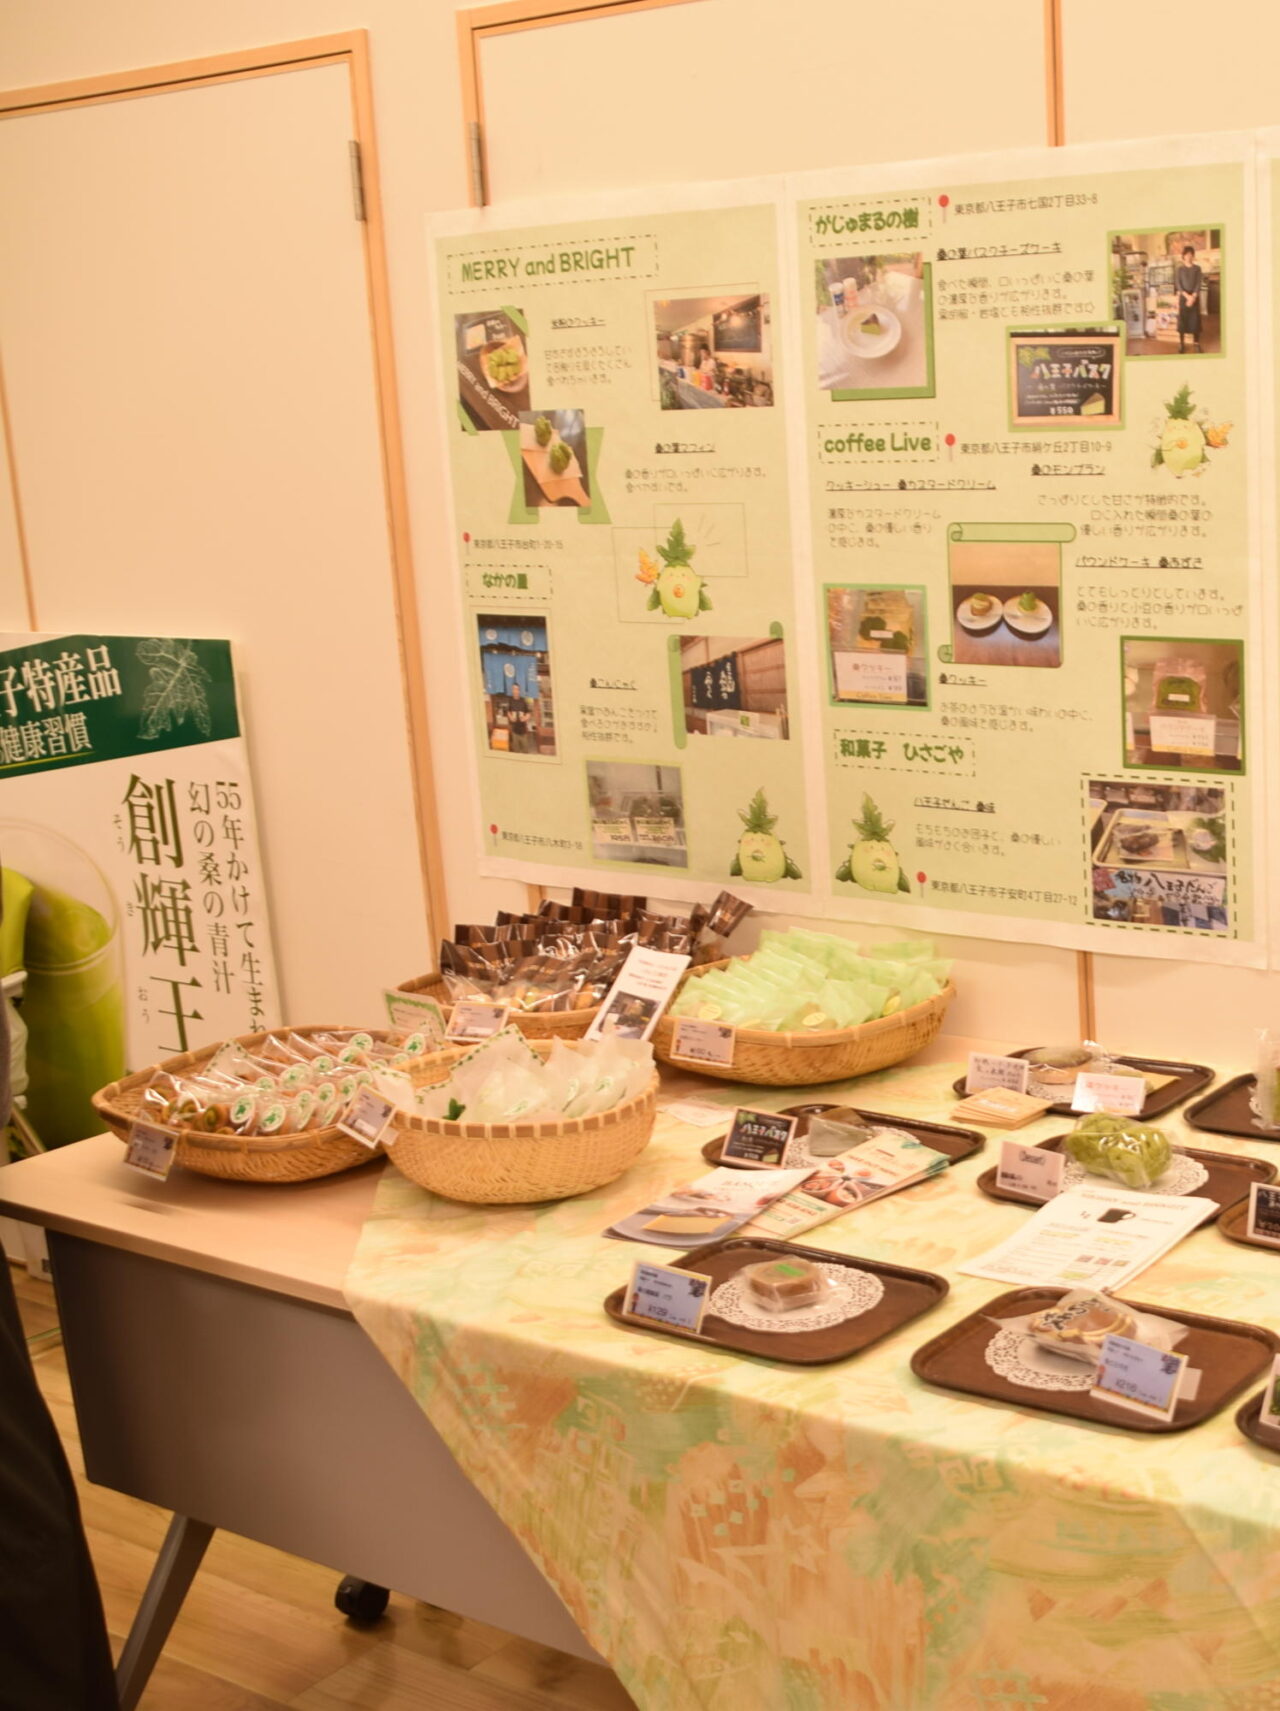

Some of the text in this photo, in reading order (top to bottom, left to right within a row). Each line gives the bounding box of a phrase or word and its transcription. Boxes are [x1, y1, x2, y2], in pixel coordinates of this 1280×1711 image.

[815, 206, 919, 235] がじゅまるの樹
[462, 246, 634, 282] MERRY and BRIGHT
[824, 432, 932, 453] coffee Live
[840, 740, 965, 764] 和菓子 ひさごや
[188, 781, 235, 995] 幻の桑の青汁
